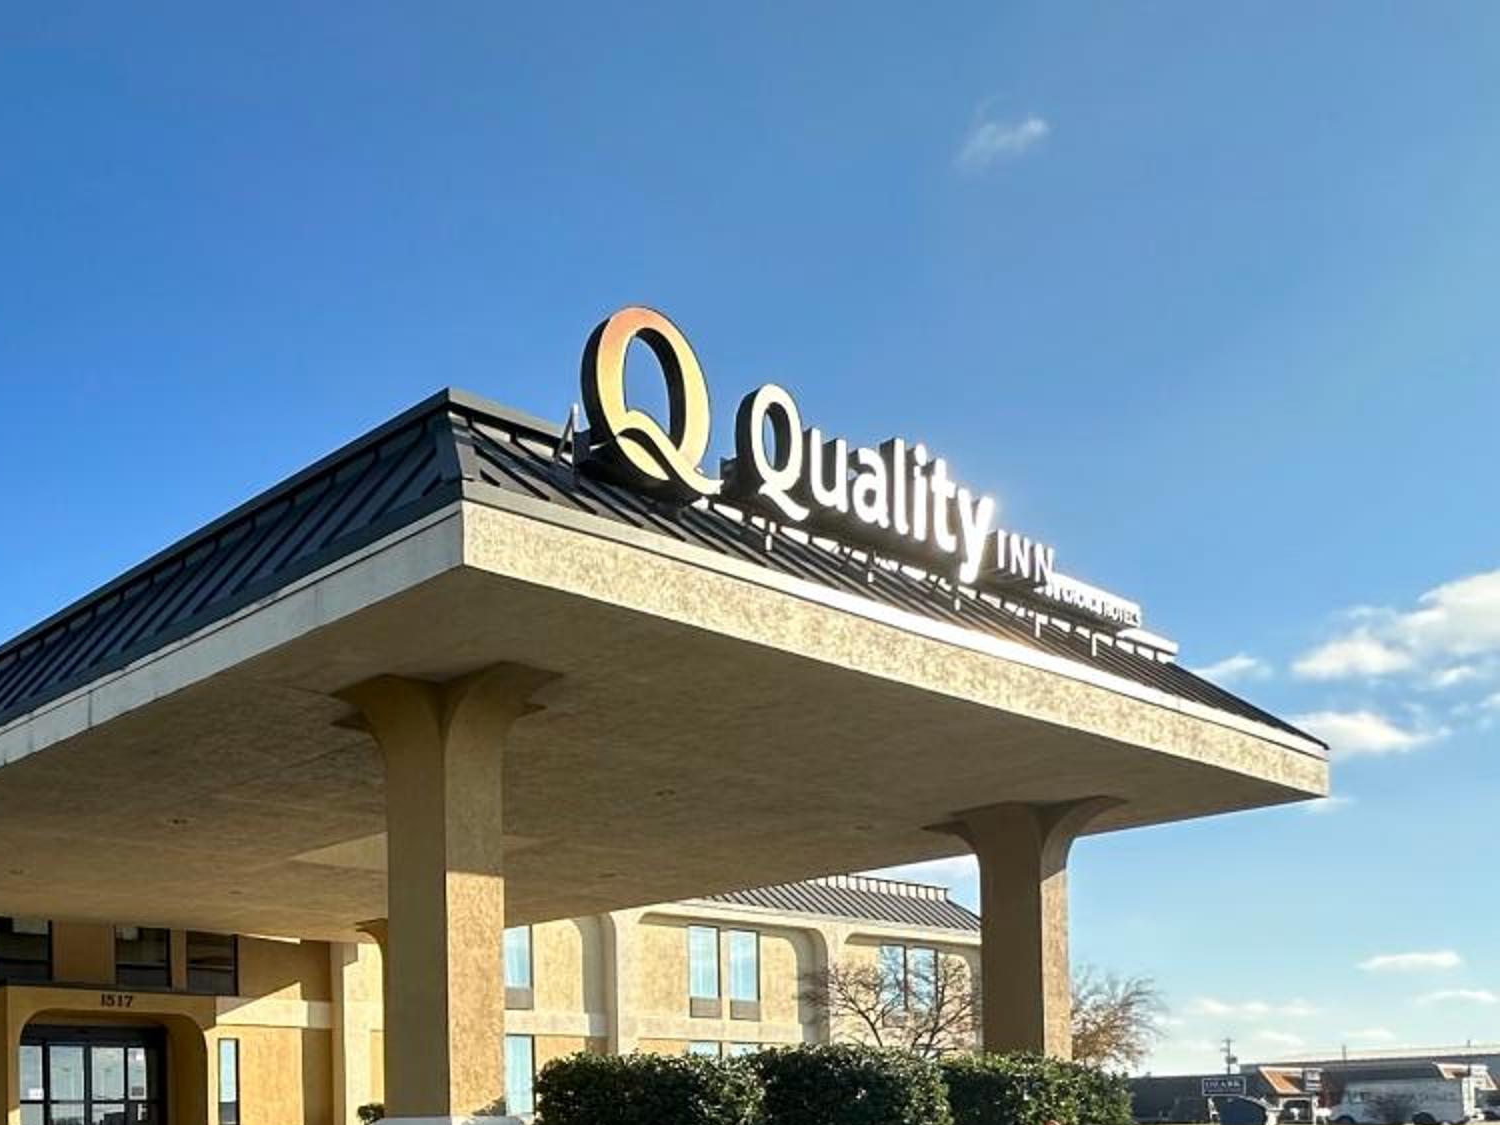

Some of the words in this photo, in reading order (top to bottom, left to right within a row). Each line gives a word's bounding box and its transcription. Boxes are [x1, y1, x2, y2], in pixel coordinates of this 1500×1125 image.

[583, 306, 722, 495] Q
[744, 383, 996, 585] Quality
[995, 528, 1056, 584] INN
[101, 993, 133, 1008] 1517
